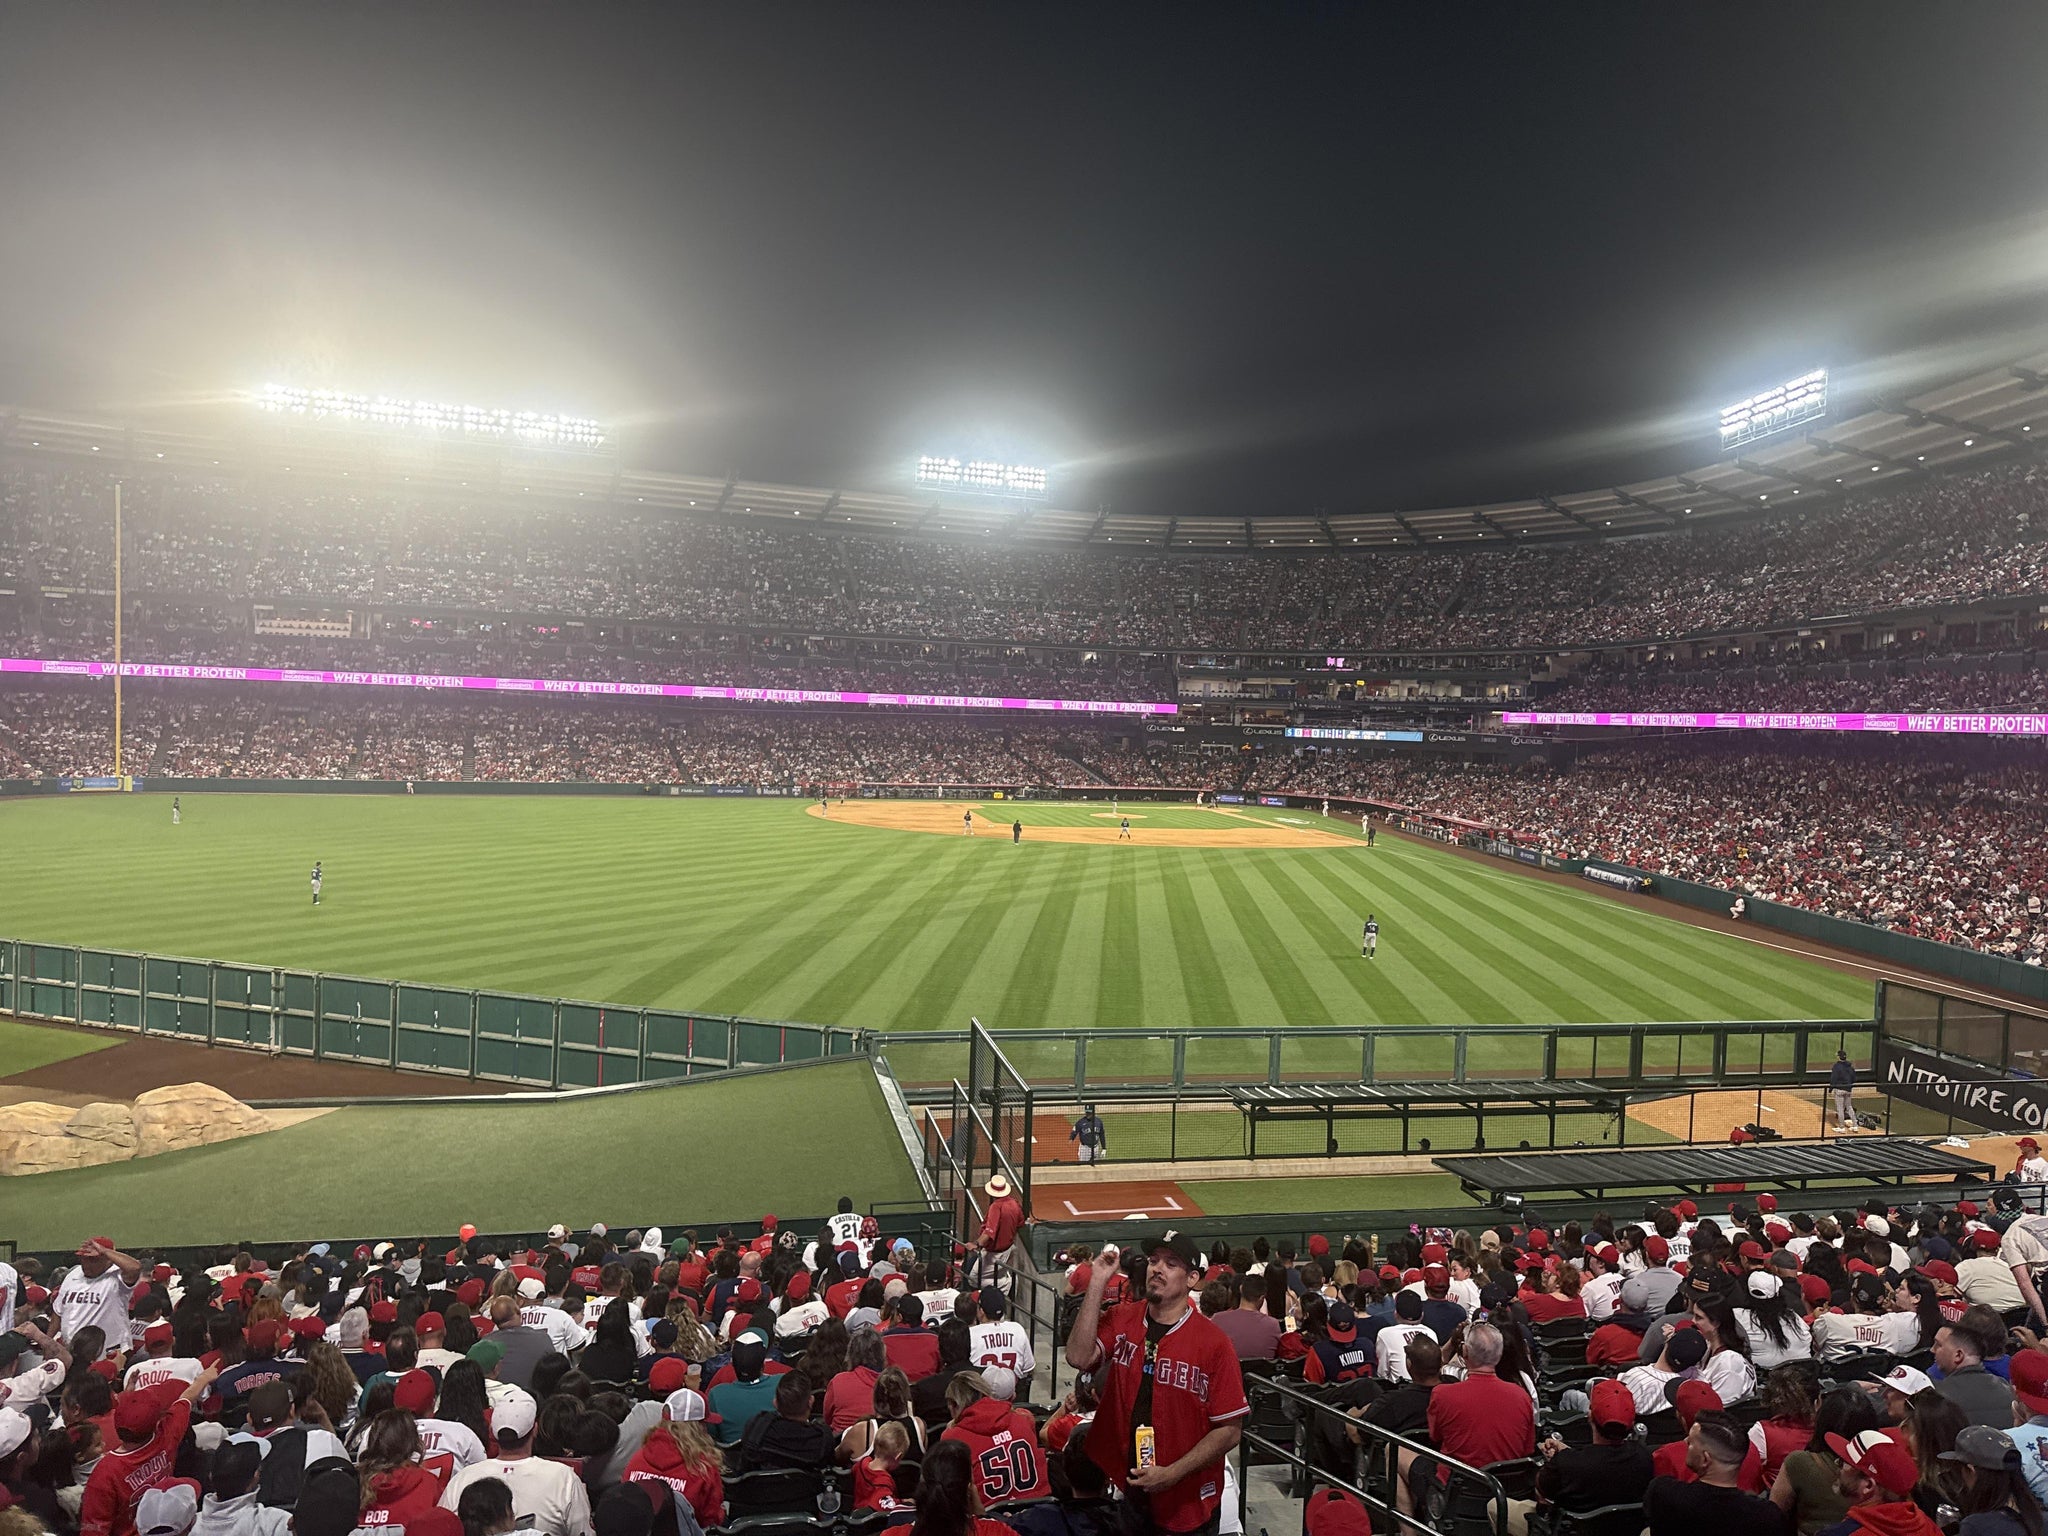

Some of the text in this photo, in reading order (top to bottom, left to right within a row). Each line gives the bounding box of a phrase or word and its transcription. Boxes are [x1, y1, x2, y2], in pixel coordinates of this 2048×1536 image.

[144, 664, 190, 678] BETTER
[193, 666, 247, 679] PROTEIN
[333, 673, 464, 687] WHEY BETTER PROTEIN
[543, 681, 575, 691] WHEY
[578, 682, 617, 693] BETTER
[619, 683, 664, 695] PROTEIN
[735, 688, 842, 702] WHEY BETTER PROTEIN
[906, 695, 932, 704] WHEY
[934, 695, 964, 705] BETTER
[967, 697, 1003, 707] PROTEIN
[1061, 700, 1087, 709] WHEY
[1088, 701, 1117, 711] BETTER
[1119, 702, 1156, 712] PROTEIN
[1631, 714, 1650, 725] WHEY
[1671, 715, 1697, 726] PROTEIN
[1745, 715, 1768, 727] WHEY
[1769, 715, 1797, 727] BETTER
[1800, 715, 1837, 728] PROTEIN
[1907, 716, 2045, 732] WHEY BETTER PROTEIN
[834, 1214, 860, 1224] CASTILLO
[841, 1222, 858, 1239] 21
[590, 1304, 606, 1316] TRO
[926, 1300, 949, 1313] TROUT
[521, 1311, 544, 1324] ROUT
[801, 1315, 819, 1329] NETO
[981, 1333, 1014, 1350] TROUT
[1853, 1326, 1884, 1345] TROUT
[138, 1370, 172, 1388] TROUT
[234, 1372, 282, 1394] TORRES
[992, 1430, 1013, 1446] BOB
[125, 1450, 172, 1491] TROUT
[978, 1438, 1039, 1500] 50
[629, 1471, 687, 1492] WITHEOON
[364, 1510, 390, 1524] BOB
